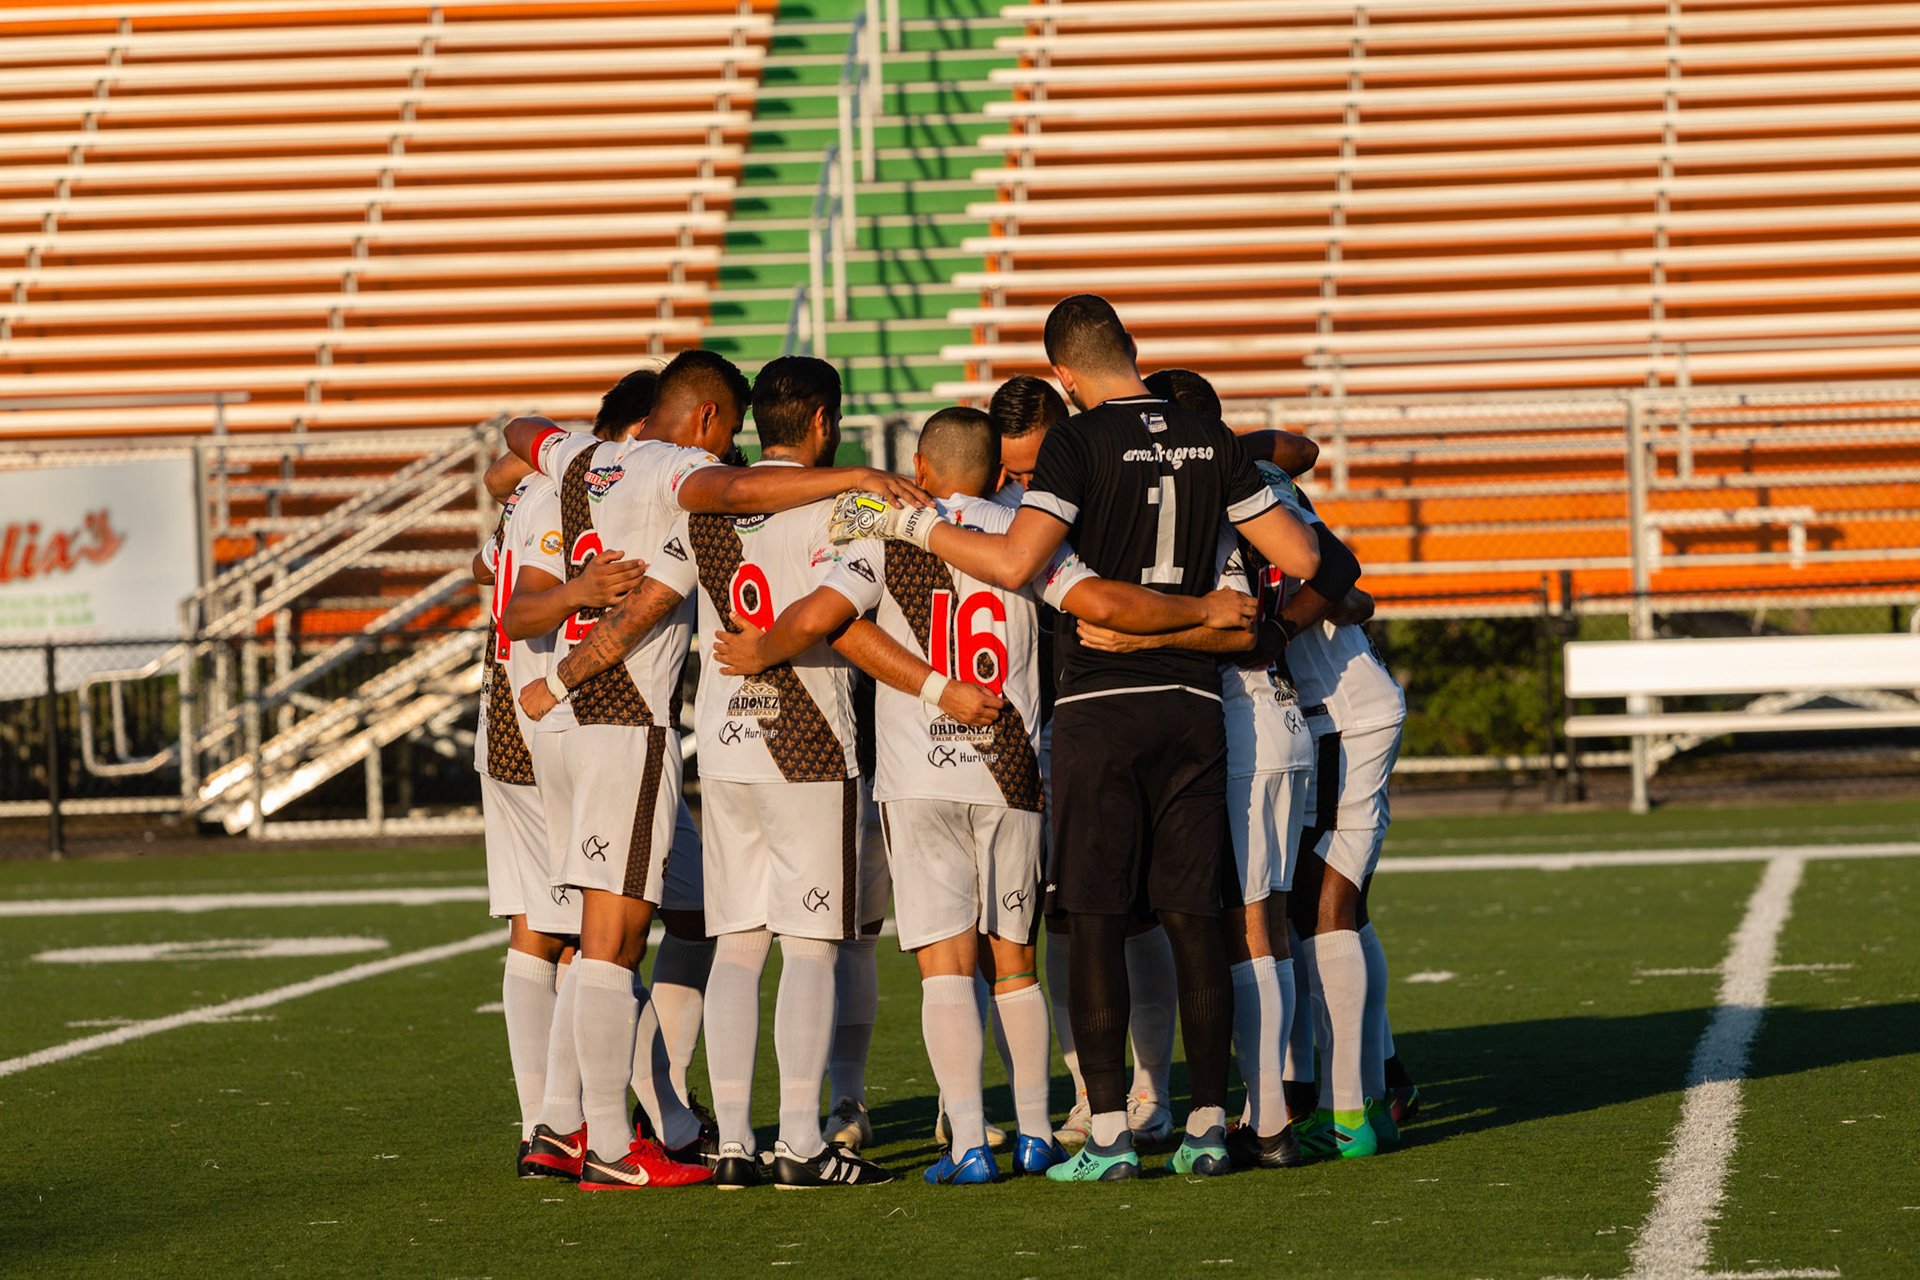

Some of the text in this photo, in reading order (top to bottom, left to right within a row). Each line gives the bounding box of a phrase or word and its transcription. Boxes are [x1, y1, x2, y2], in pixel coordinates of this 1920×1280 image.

[905, 507, 925, 537] JUSTIN
[1141, 475, 1184, 585] 1
[729, 561, 776, 633] 9
[928, 588, 1008, 696] 16
[744, 709, 777, 717] COMPANY
[744, 727, 779, 739] Huriver
[929, 722, 993, 736] ORDONEZ
[959, 752, 999, 763] Huriver
[722, 1147, 743, 1155] adidas
[1072, 1159, 1101, 1183] adidas
